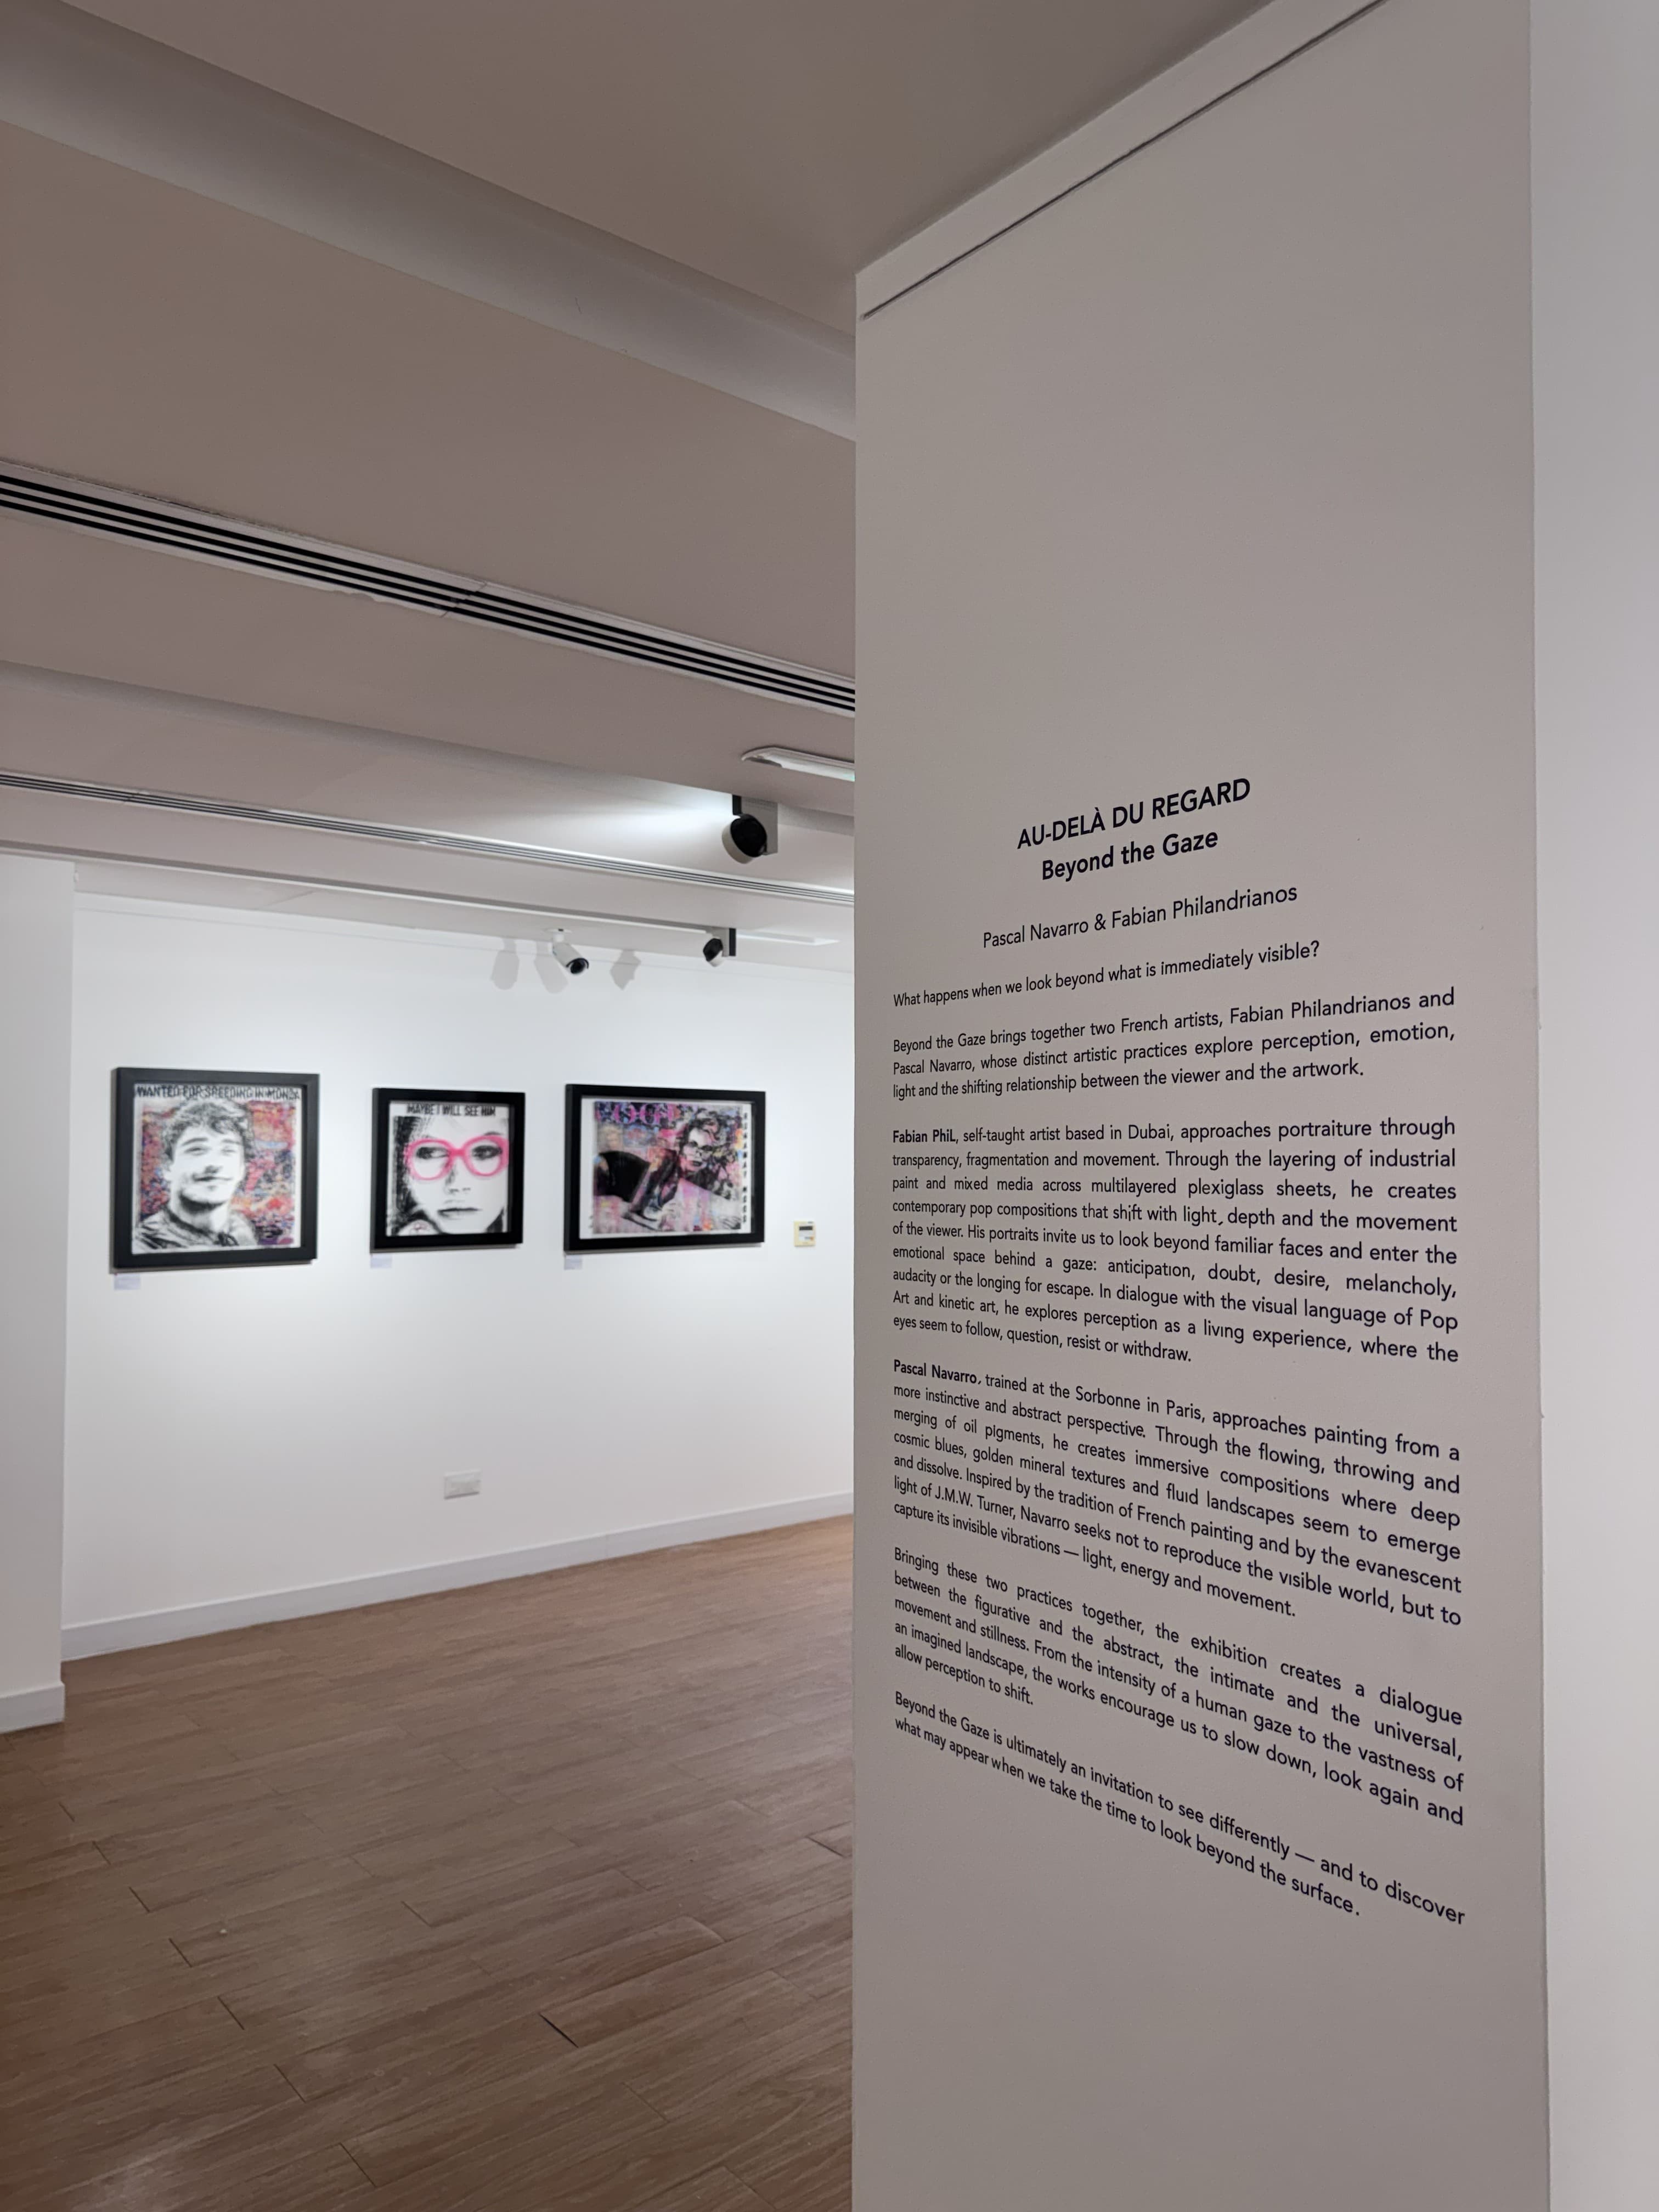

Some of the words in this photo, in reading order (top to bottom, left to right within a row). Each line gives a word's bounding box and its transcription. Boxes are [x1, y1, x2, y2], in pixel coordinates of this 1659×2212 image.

[1017, 806, 1106, 850] AU-DELÀ
[1113, 801, 1144, 828] DU
[1152, 778, 1250, 820] REGARD
[1042, 845, 1114, 882] Beyond
[1120, 840, 1155, 865] the
[1163, 832, 1218, 856] Gaze
[983, 924, 1025, 949] Pascal
[1030, 921, 1089, 941] Navarro
[1094, 913, 1107, 931] &
[1112, 906, 1166, 929] Fabian
[1173, 887, 1297, 919] Philandrianos
[893, 992, 921, 1007] What
[923, 989, 969, 1006] happens
[971, 982, 1002, 998] when
[1005, 982, 1023, 994] we
[1026, 974, 1052, 991] look
[1056, 967, 1104, 990] beyond
[1108, 964, 1142, 981] what
[1146, 962, 1156, 977] is
[1161, 948, 1254, 975] immediately
[1258, 940, 1320, 963] visible?
[893, 1035, 932, 1055] Beyond
[935, 1034, 953, 1049] the
[957, 1032, 986, 1047] Gaze
[990, 1029, 1026, 1046] brings
[1030, 1022, 1086, 1043] together
[1090, 1023, 1115, 1036] two
[1121, 1013, 1168, 1033] French
[1174, 1011, 1223, 1029] artists,
[1230, 1005, 1283, 1024] Fabian
[1291, 995, 1411, 1019] Philandrianos
[1419, 985, 1454, 1008] and
[893, 1083, 916, 1101] light
[918, 1081, 938, 1097] and
[940, 1080, 959, 1096] the
[961, 1079, 1003, 1097] shifting
[1006, 1074, 1077, 1093] relationship
[1081, 1073, 1139, 1088] between
[1143, 1068, 1167, 1085] the
[1171, 1068, 1221, 1084] viewer
[1225, 1062, 1255, 1081] and
[1259, 1062, 1286, 1080] the
[1292, 1057, 1364, 1078] artwork.
[892, 1154, 962, 1170] transparency,
[966, 1151, 1049, 1170] fragmentation
[1054, 1150, 1077, 1166] and
[1083, 1153, 1159, 1166] movement.
[1165, 1149, 1229, 1171] Through
[1235, 1149, 1262, 1167] the
[1269, 1149, 1336, 1172] layering
[1344, 1148, 1363, 1167] of
[1369, 1147, 1455, 1167] industrial
[893, 1128, 928, 1143] Fabian
[933, 1128, 959, 1145] PhiL,
[963, 1126, 1025, 1146] self-taught
[1029, 1126, 1060, 1141] artist
[1065, 1124, 1104, 1141] based
[1110, 1124, 1122, 1140] in
[1128, 1122, 1174, 1142] Dubai,
[1181, 1120, 1271, 1143] approaches
[1278, 1119, 1372, 1142] portraiture
[1379, 1115, 1455, 1141] through
[893, 1176, 919, 1192] paint
[926, 1175, 946, 1189] and
[954, 1175, 988, 1190] mixed
[997, 1176, 1033, 1191] media
[1042, 1181, 1082, 1192] across
[1091, 1176, 1176, 1198] multilayered
[1188, 1177, 1264, 1200] plexiglass
[1276, 1178, 1336, 1200] sheets,
[1351, 1179, 1373, 1198] he
[1387, 1183, 1457, 1200] creates
[893, 1317, 917, 1330] eyes
[919, 1319, 947, 1332] seem
[950, 1321, 963, 1334] to
[965, 1319, 1003, 1341] follow,
[1006, 1329, 1063, 1348] question,
[1066, 1334, 1101, 1351] resist
[1104, 1341, 1119, 1352] or
[1122, 1340, 1192, 1362] withdraw.
[894, 1386, 921, 1400] more
[926, 1387, 980, 1409] instinctive
[985, 1398, 1007, 1414] and
[1012, 1401, 1062, 1424] abstract
[1067, 1414, 1146, 1438] perspective.
[1155, 1425, 1218, 1454] Through
[1224, 1437, 1251, 1458] the
[1258, 1442, 1325, 1475] flowing,
[1333, 1455, 1414, 1491] throwing
[1424, 1474, 1460, 1494] and
[894, 1503, 934, 1522] capture
[937, 1510, 950, 1526] its
[952, 1514, 998, 1538] invisible
[1000, 1527, 1060, 1555] vibrations
[1082, 1545, 1116, 1572] light,
[1120, 1561, 1170, 1588] energy
[1174, 1575, 1201, 1592] and
[1206, 1583, 1295, 1617] movement.
[894, 1547, 939, 1576] Bringing
[946, 1561, 978, 1583] these
[985, 1575, 1008, 1593] two
[1017, 1585, 1073, 1612] practices
[1082, 1602, 1144, 1636] together,
[1155, 1622, 1180, 1643] the
[1190, 1635, 1267, 1669] exhibition
[1280, 1663, 1341, 1690] creates
[1355, 1684, 1365, 1697] a
[1379, 1686, 1462, 1725] dialogue
[895, 1644, 923, 1665] allow
[925, 1657, 985, 1688] perception
[988, 1678, 1001, 1693] to
[1005, 1682, 1034, 1705] shift.
[895, 1623, 907, 1635] an
[911, 1624, 962, 1654] imagined
[966, 1641, 1028, 1679] landscape,
[1032, 1665, 1053, 1685] the
[1057, 1677, 1096, 1700] works
[1100, 1693, 1175, 1728] encourage
[1181, 1719, 1197, 1735] us
[1201, 1724, 1218, 1741] to
[1224, 1730, 1260, 1756] slow
[1266, 1743, 1317, 1778] down,
[1324, 1760, 1363, 1791] look
[1369, 1782, 1419, 1811] again
[1427, 1802, 1463, 1826] and
[895, 1690, 935, 1719] Beyond
[938, 1708, 957, 1727] the
[961, 1717, 990, 1740] Gaze
[994, 1729, 1003, 1745] is
[1006, 1735, 1067, 1774] ultimately
[1070, 1763, 1086, 1778] an
[1090, 1767, 1153, 1804] invitation
[1158, 1793, 1173, 1812] to
[1178, 1804, 1204, 1824] see
[1209, 1812, 1290, 1861] differently
[1321, 1859, 1353, 1882] and
[1358, 1871, 1379, 1891] to
[1385, 1880, 1465, 1925] discover
